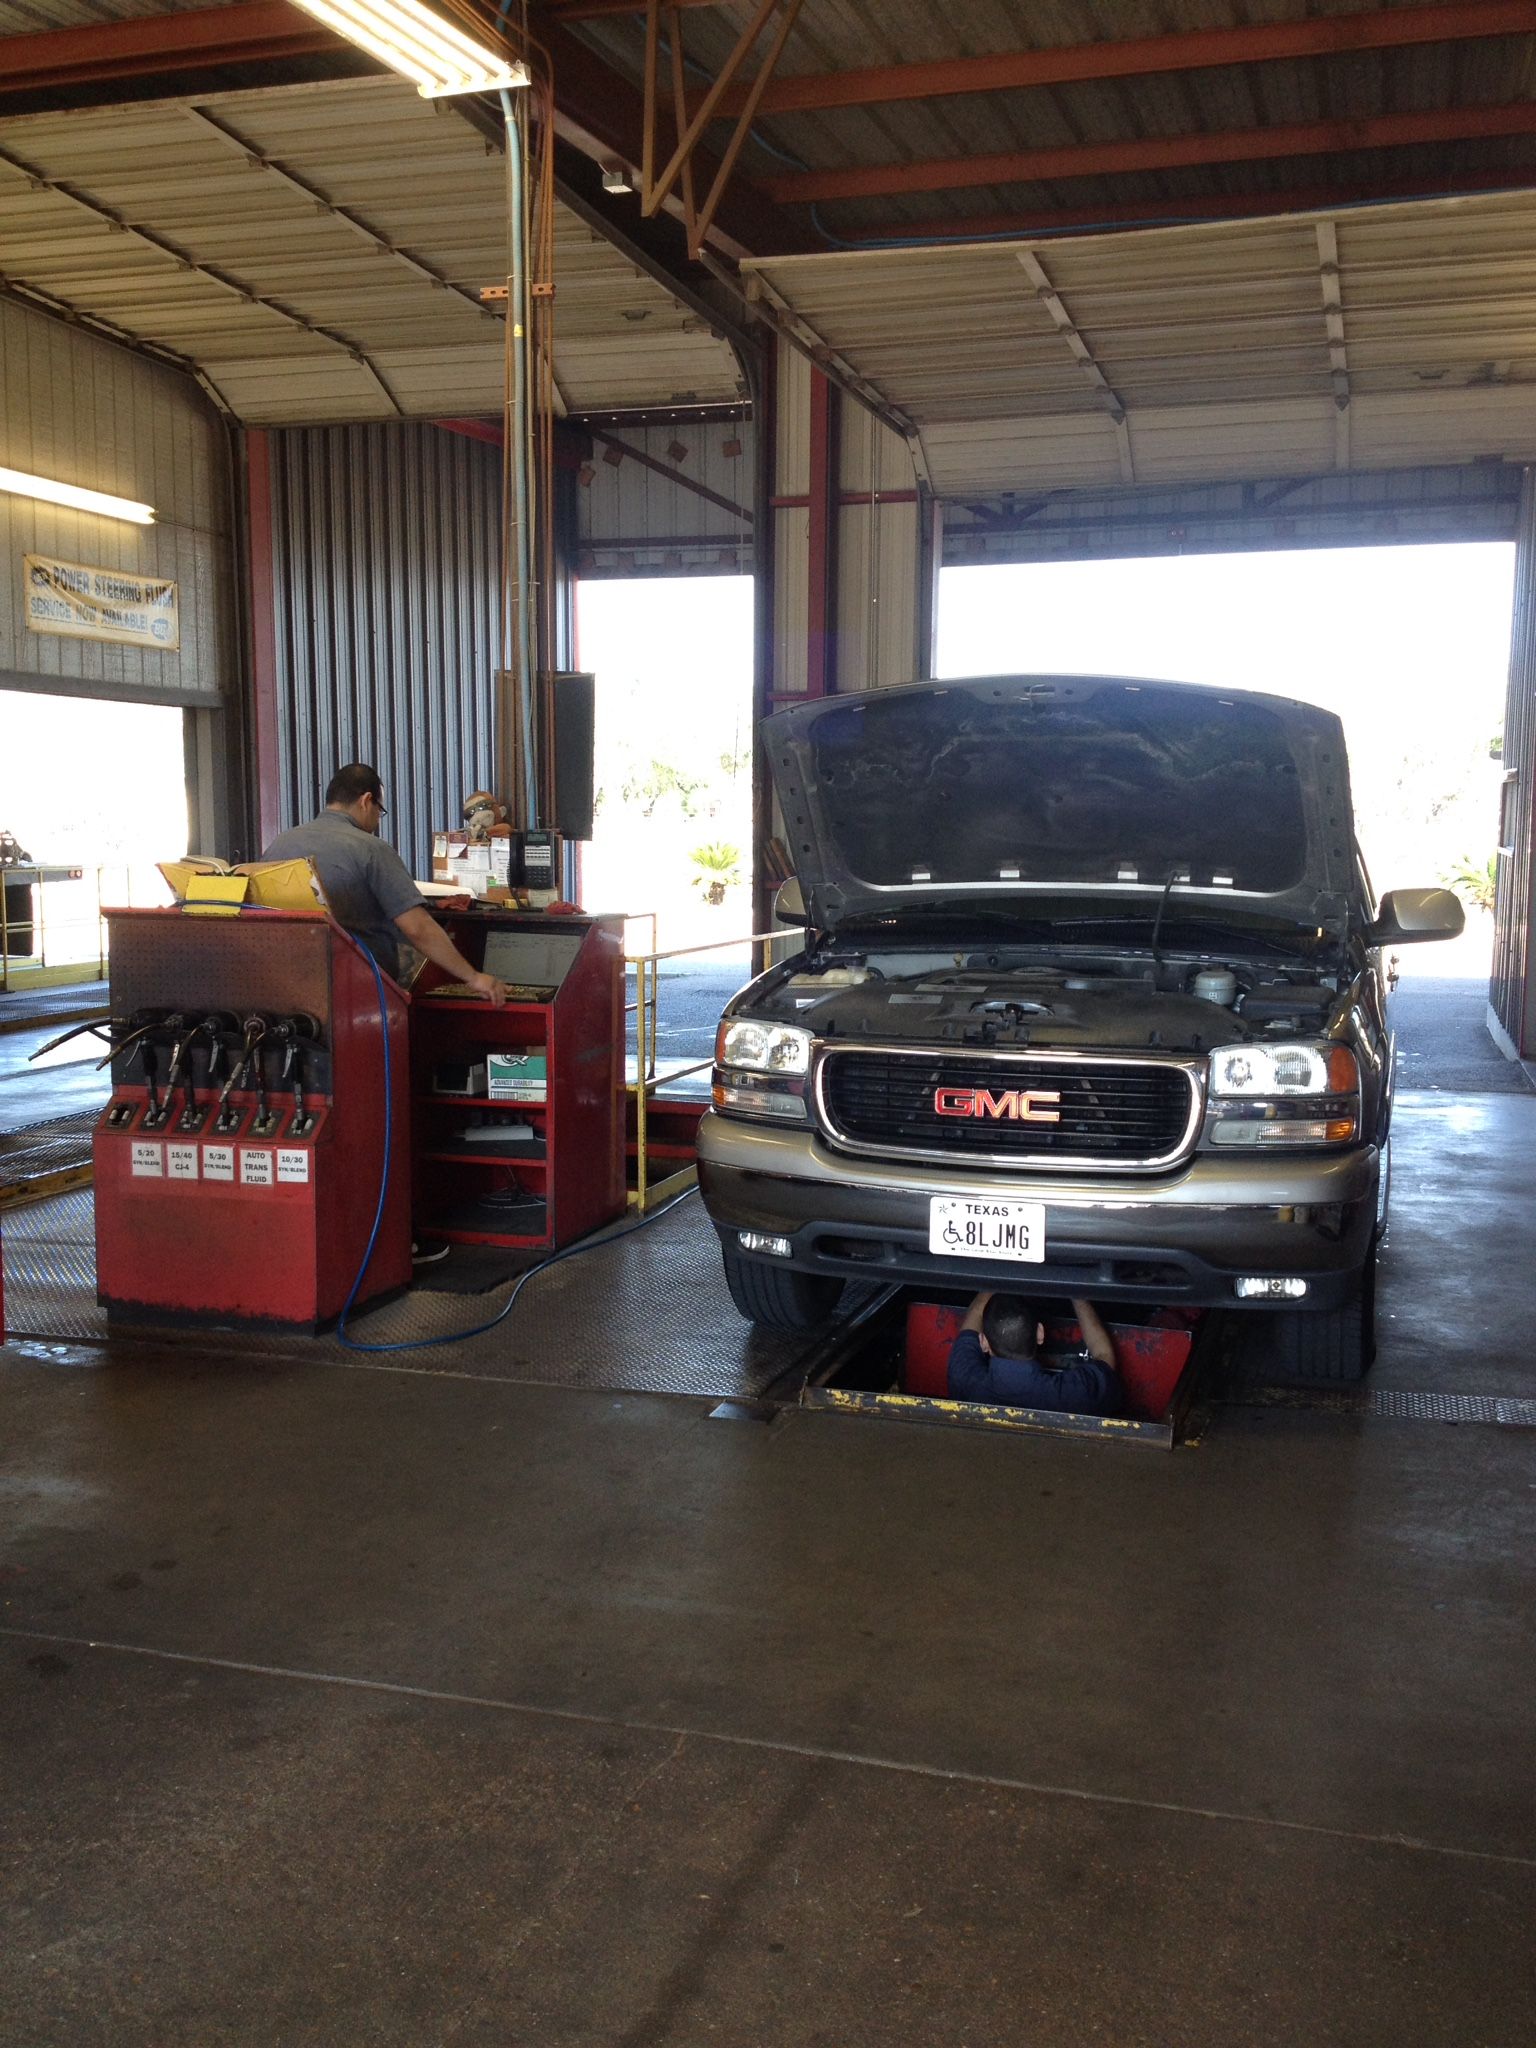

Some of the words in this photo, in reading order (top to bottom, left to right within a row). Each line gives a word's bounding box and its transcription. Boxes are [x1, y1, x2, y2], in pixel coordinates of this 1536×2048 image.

[53, 566, 90, 595] POWER
[94, 574, 142, 603] STEERING
[31, 597, 72, 619] SERVICE
[75, 603, 97, 623] NOW
[935, 1087, 1061, 1122] GMC
[137, 1149, 155, 1157] 5/20
[171, 1151, 193, 1159] 15/40
[209, 1152, 226, 1160] 5/30
[281, 1156, 303, 1164] 10/30
[244, 1163, 268, 1171] TRANS
[246, 1175, 267, 1183] FLUID
[965, 1204, 1009, 1217] TEXAS
[966, 1221, 1029, 1250] 8LJMG
